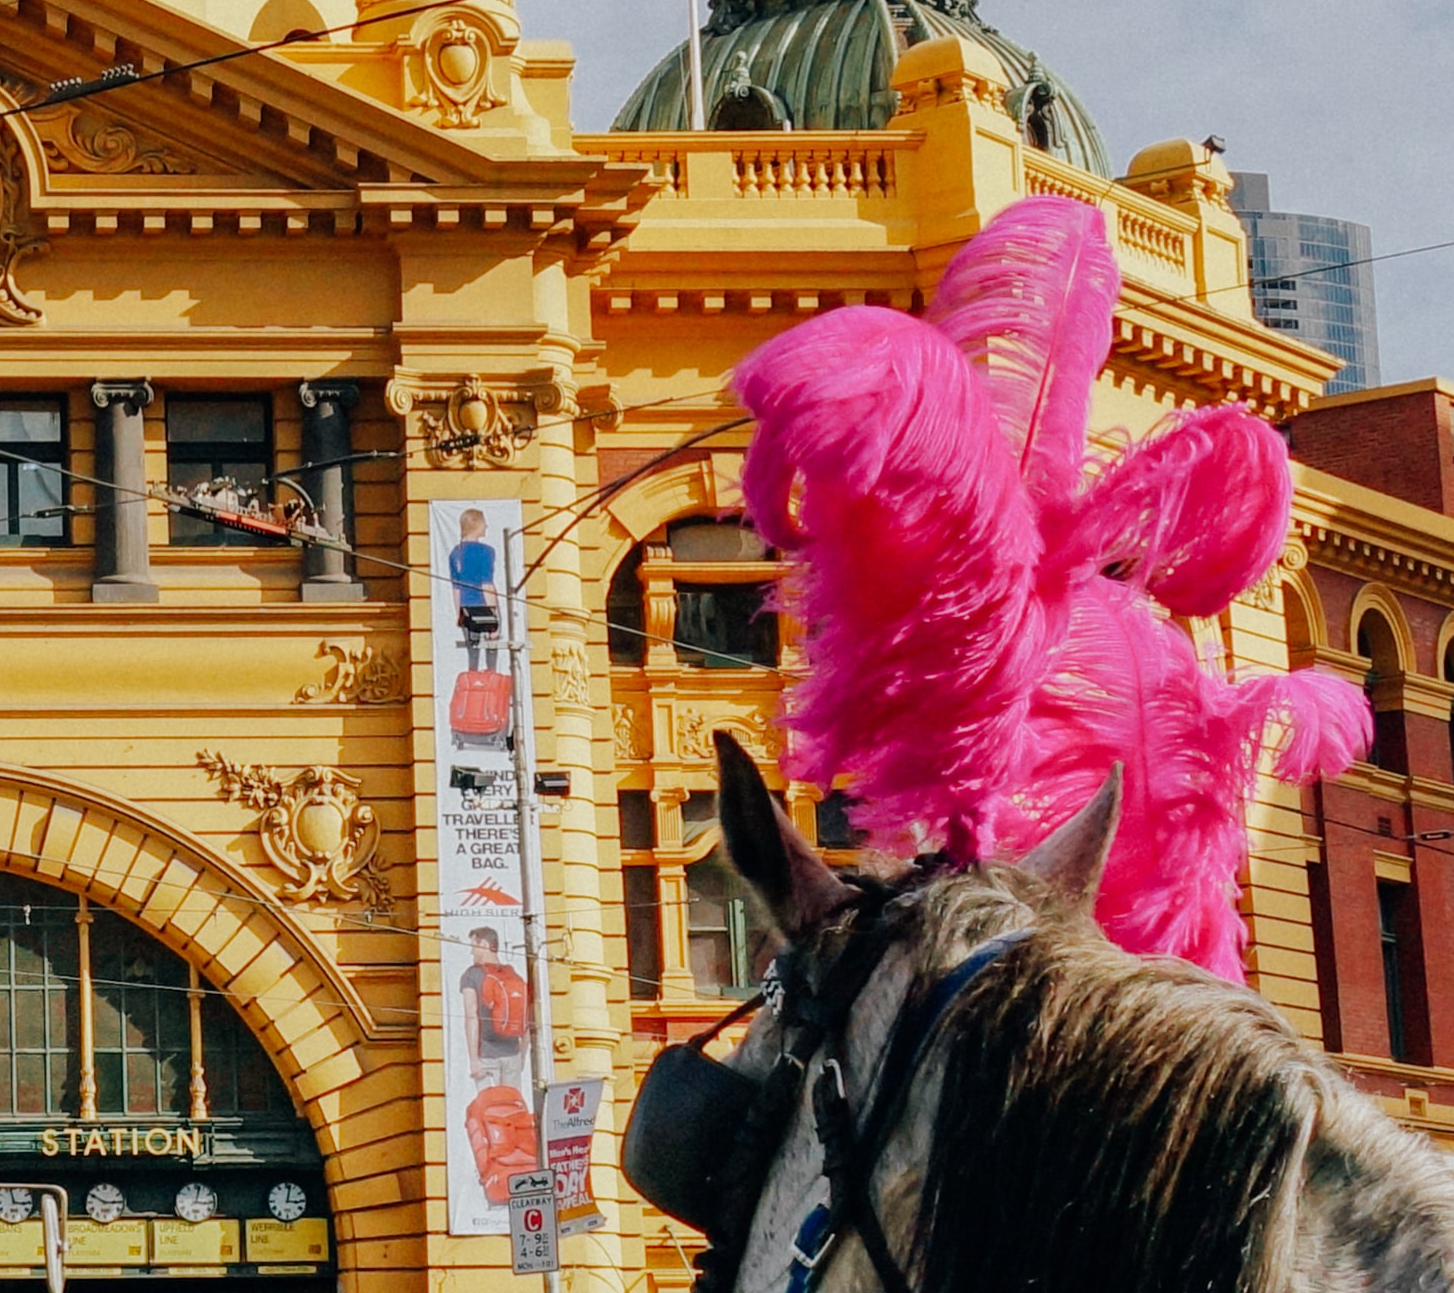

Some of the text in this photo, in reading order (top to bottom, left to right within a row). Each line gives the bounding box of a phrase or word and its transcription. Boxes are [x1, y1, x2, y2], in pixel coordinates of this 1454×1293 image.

[442, 814, 534, 825] TRAVELLE
[456, 843, 466, 854] A
[472, 858, 508, 869] BAG.
[42, 1127, 201, 1157] STATION
[555, 1168, 588, 1196] DAY
[527, 1210, 539, 1231] C
[68, 1224, 141, 1233] BROADMEADOWS
[159, 1223, 194, 1232] UPFIELD
[160, 1236, 178, 1244] LINE
[250, 1235, 269, 1244] LINE
